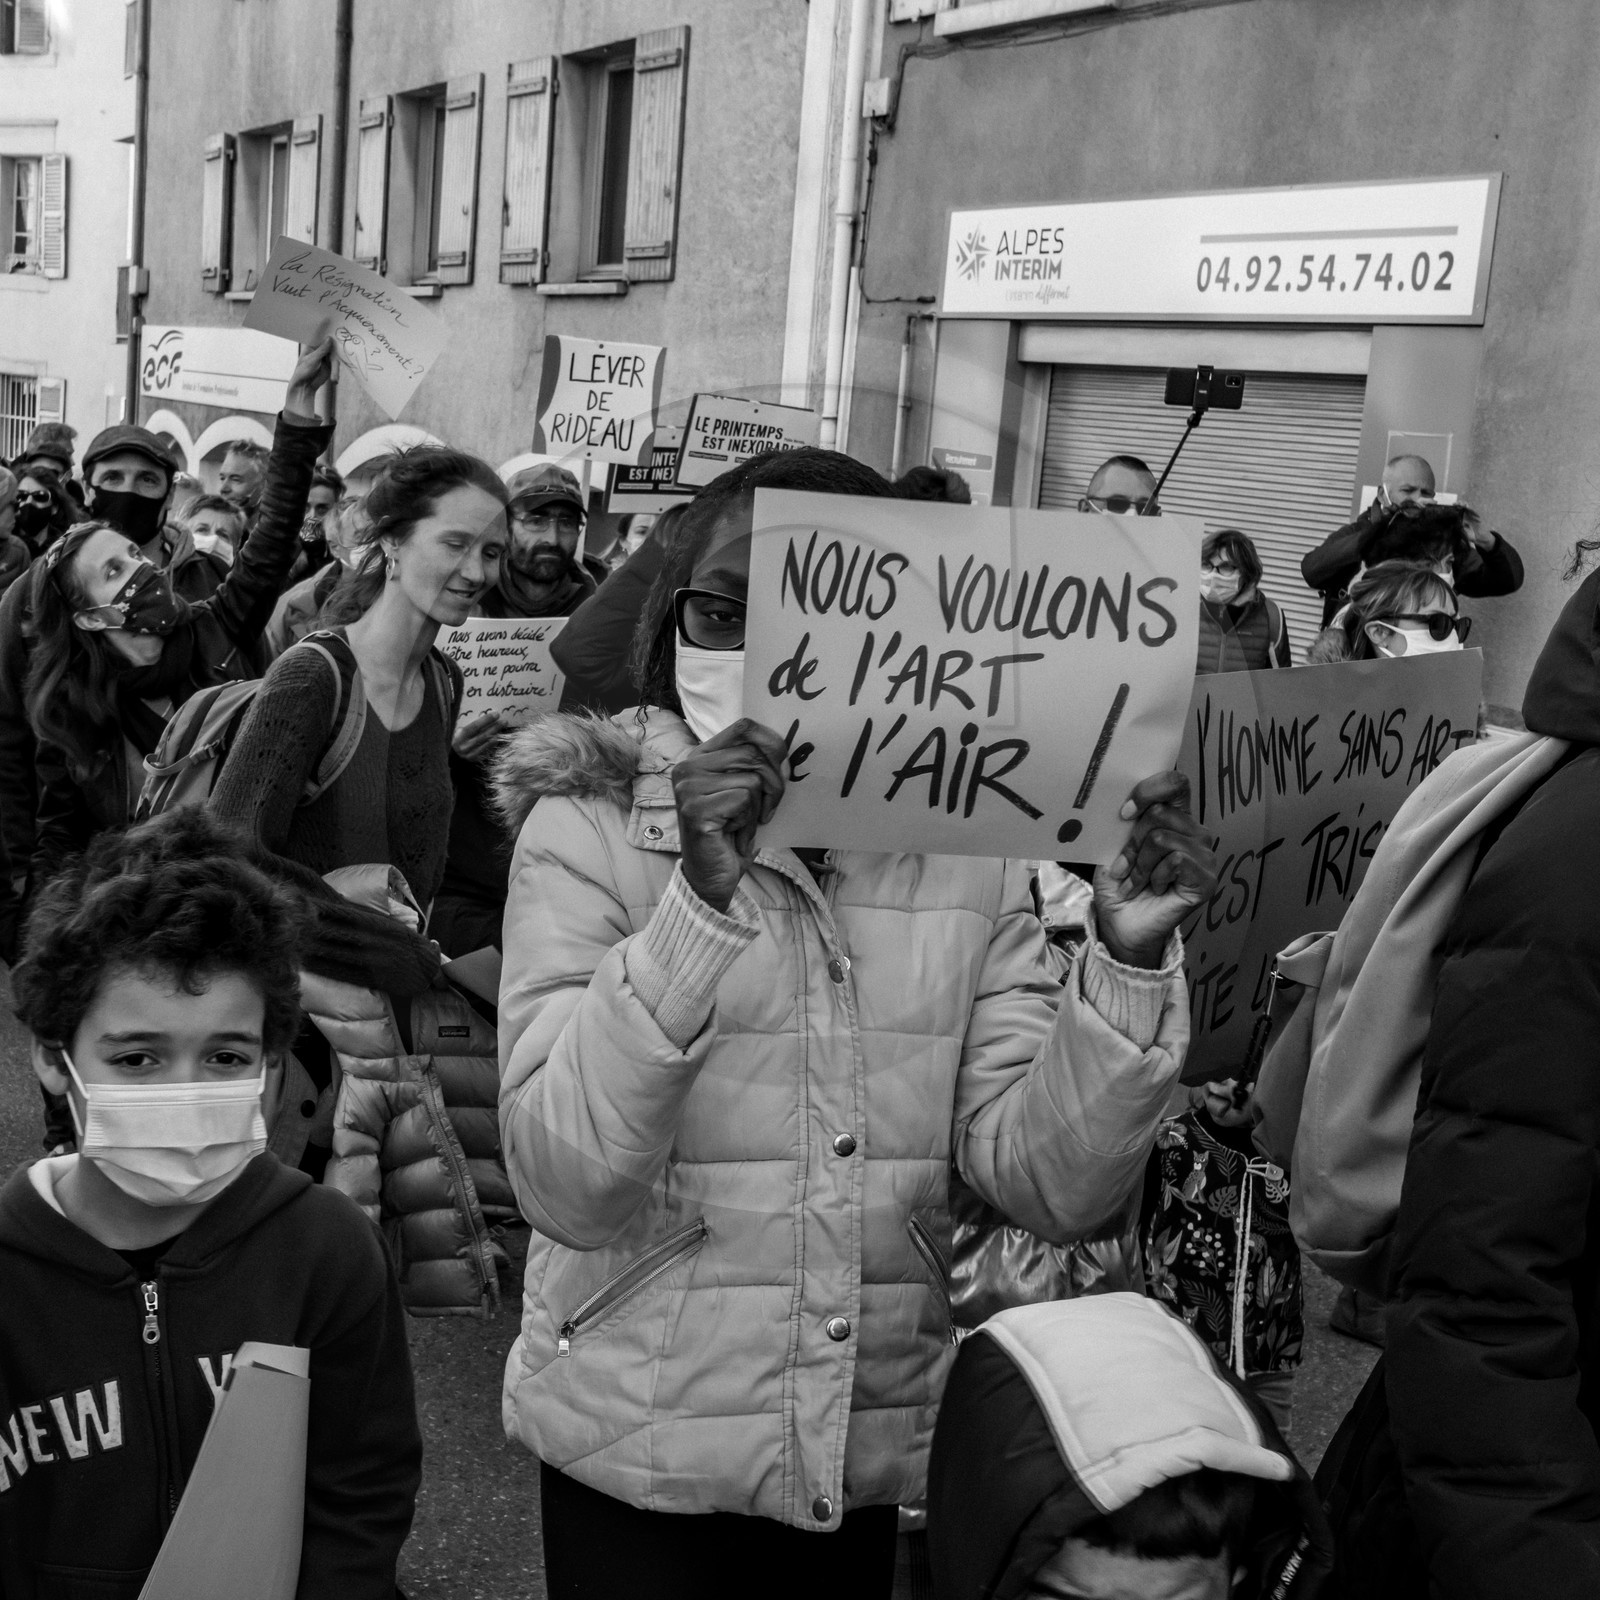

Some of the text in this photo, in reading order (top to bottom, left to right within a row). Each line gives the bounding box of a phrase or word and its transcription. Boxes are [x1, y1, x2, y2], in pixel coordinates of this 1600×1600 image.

[996, 228, 1065, 256] ALPES
[994, 258, 1062, 281] INTERIM
[1196, 250, 1455, 293] 04.92.54.74.02
[568, 352, 646, 388] LEVER
[586, 389, 613, 412] DE
[695, 415, 784, 440] LE PRINTEMPS
[701, 435, 726, 450] EST
[651, 452, 680, 466] INTE
[628, 468, 650, 480] EST
[781, 530, 1178, 648] NOUS VOULONS
[483, 665, 497, 676] ne
[500, 662, 541, 681] pourra
[768, 631, 827, 701] de
[1333, 707, 1407, 784] SANS
[0, 1379, 123, 1492] NEW
